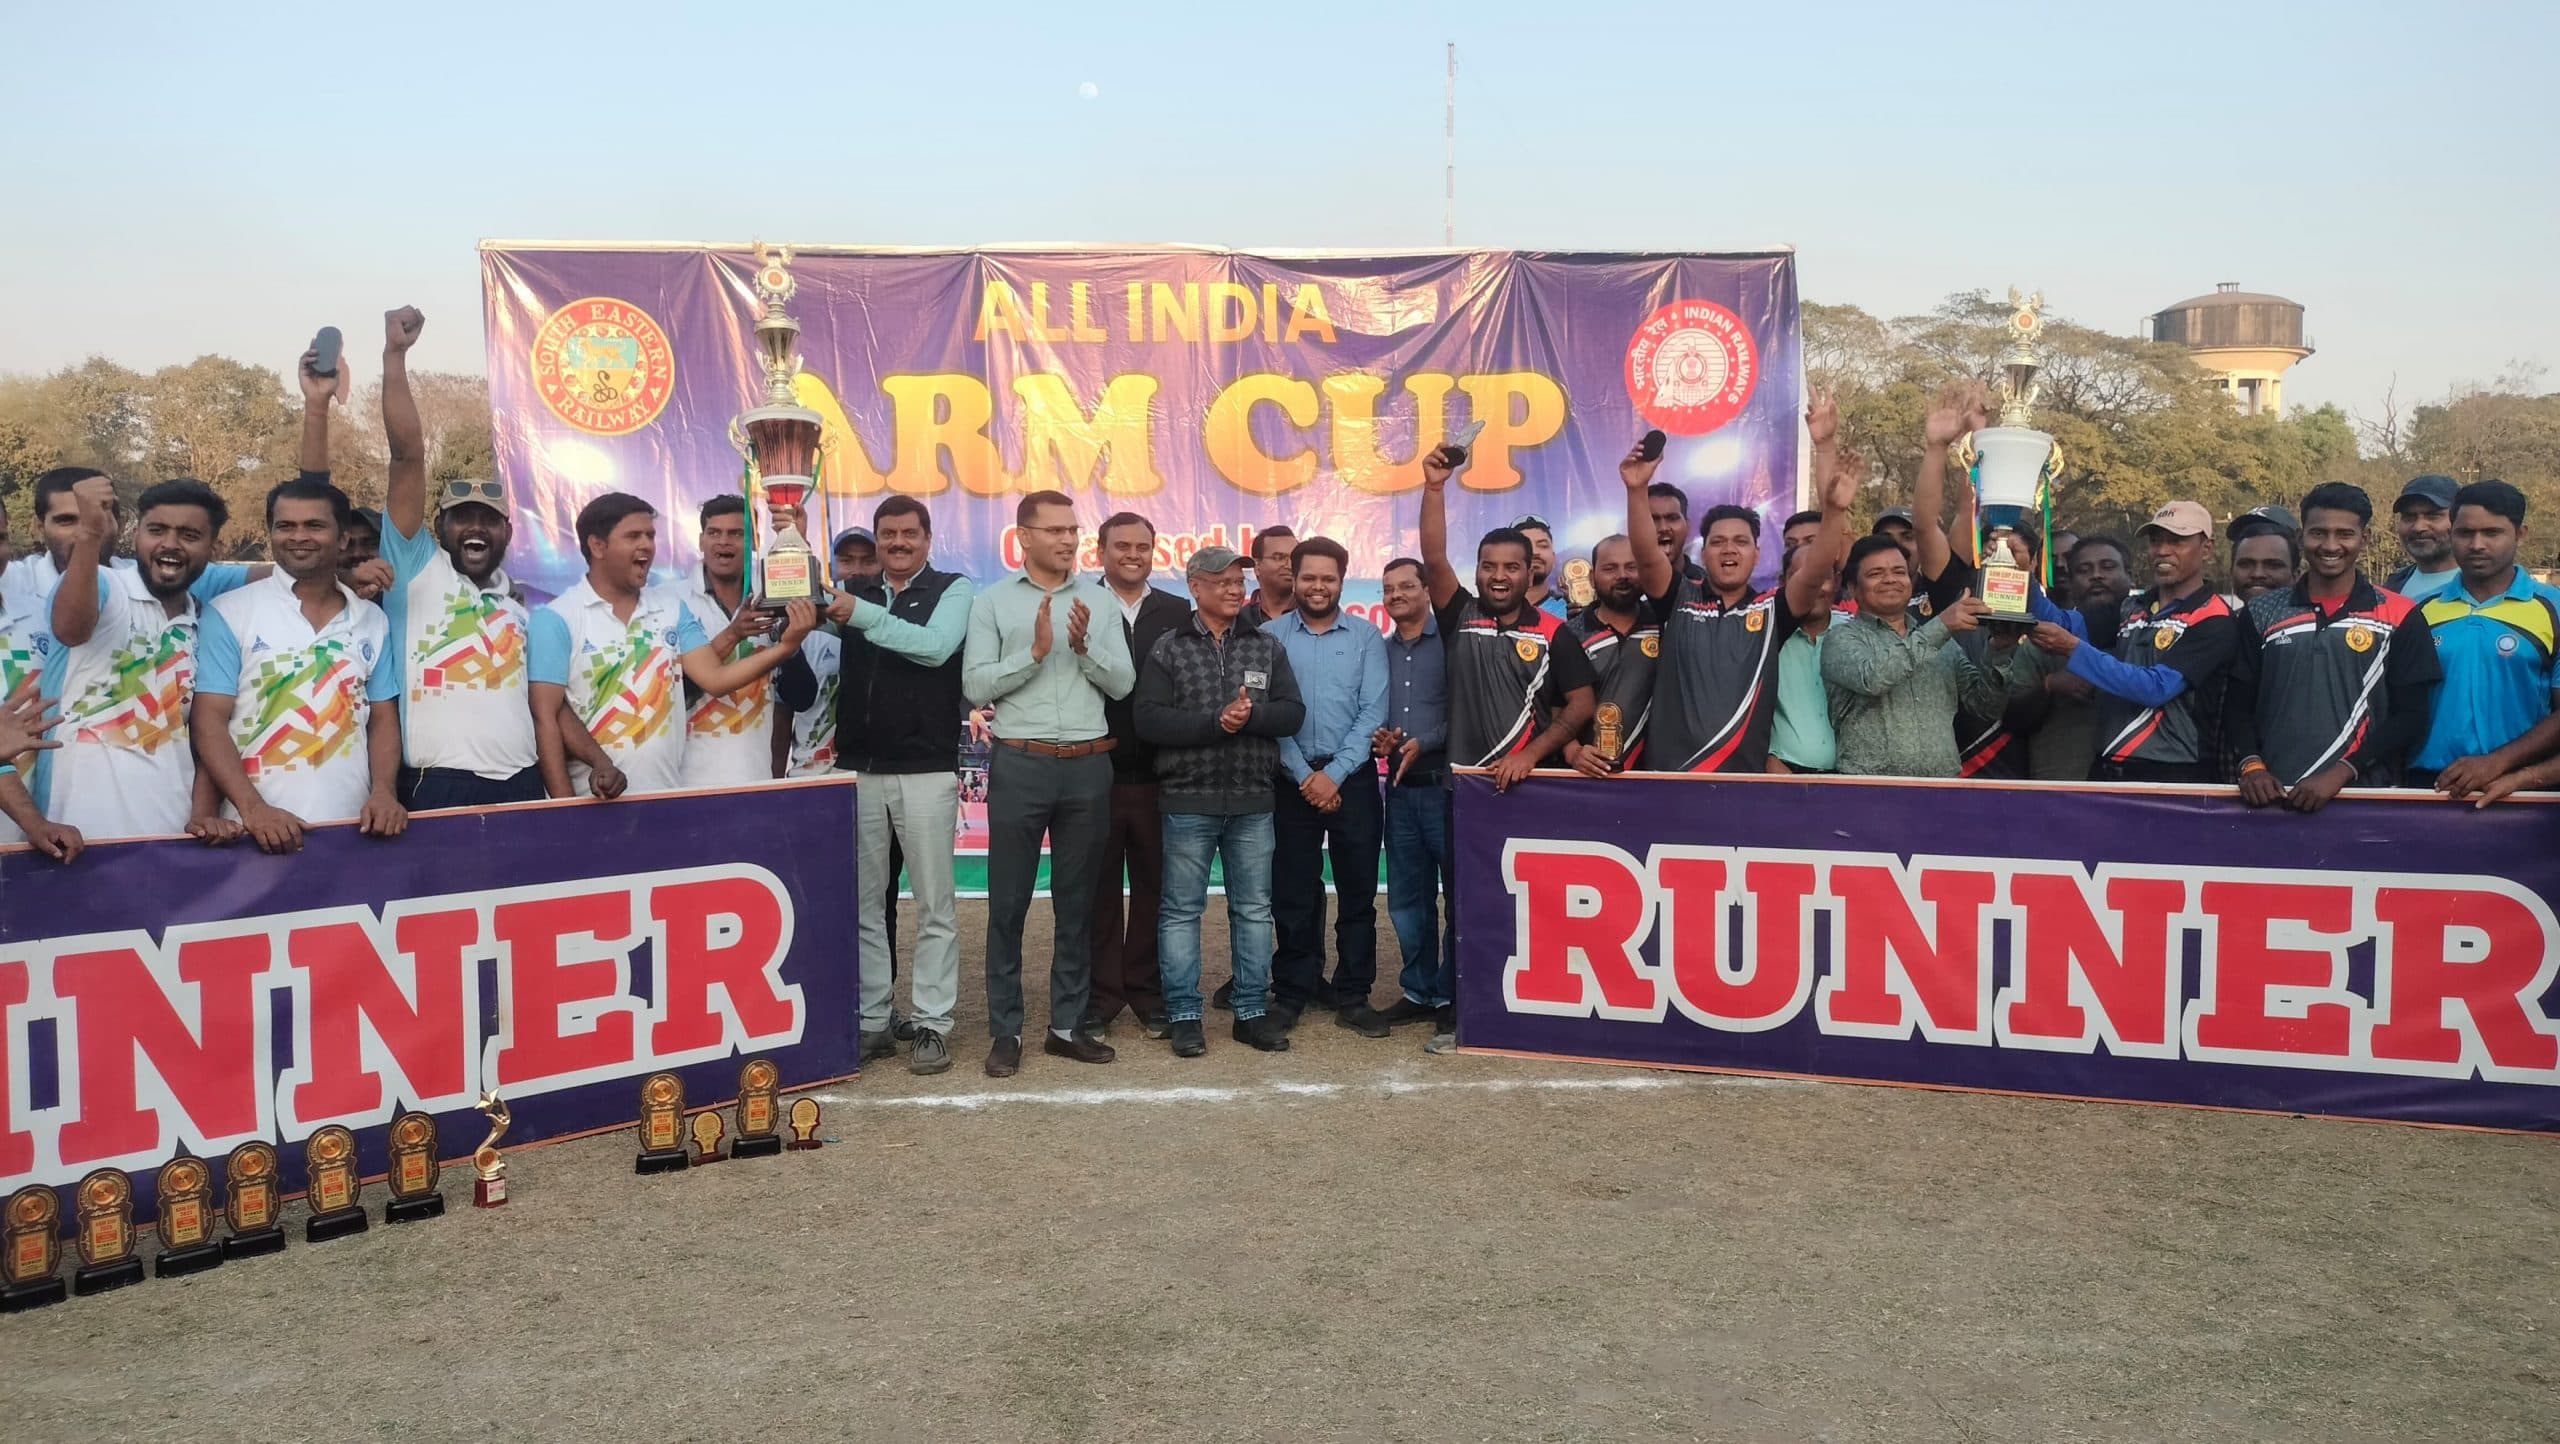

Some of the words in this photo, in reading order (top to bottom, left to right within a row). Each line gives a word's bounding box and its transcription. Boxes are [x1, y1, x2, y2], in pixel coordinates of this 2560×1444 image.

[539, 313, 578, 376] SOUTH
[590, 303, 668, 381] EASTERN
[974, 280, 1108, 342] ALL
[1128, 282, 1338, 344] INDIA
[1683, 306, 1735, 333] INDIAN
[1727, 331, 1751, 405] RAILWAYS
[556, 398, 651, 429] RAILWAY
[1205, 371, 1568, 494] CUP
[1506, 843, 2560, 1080] RUNNER
